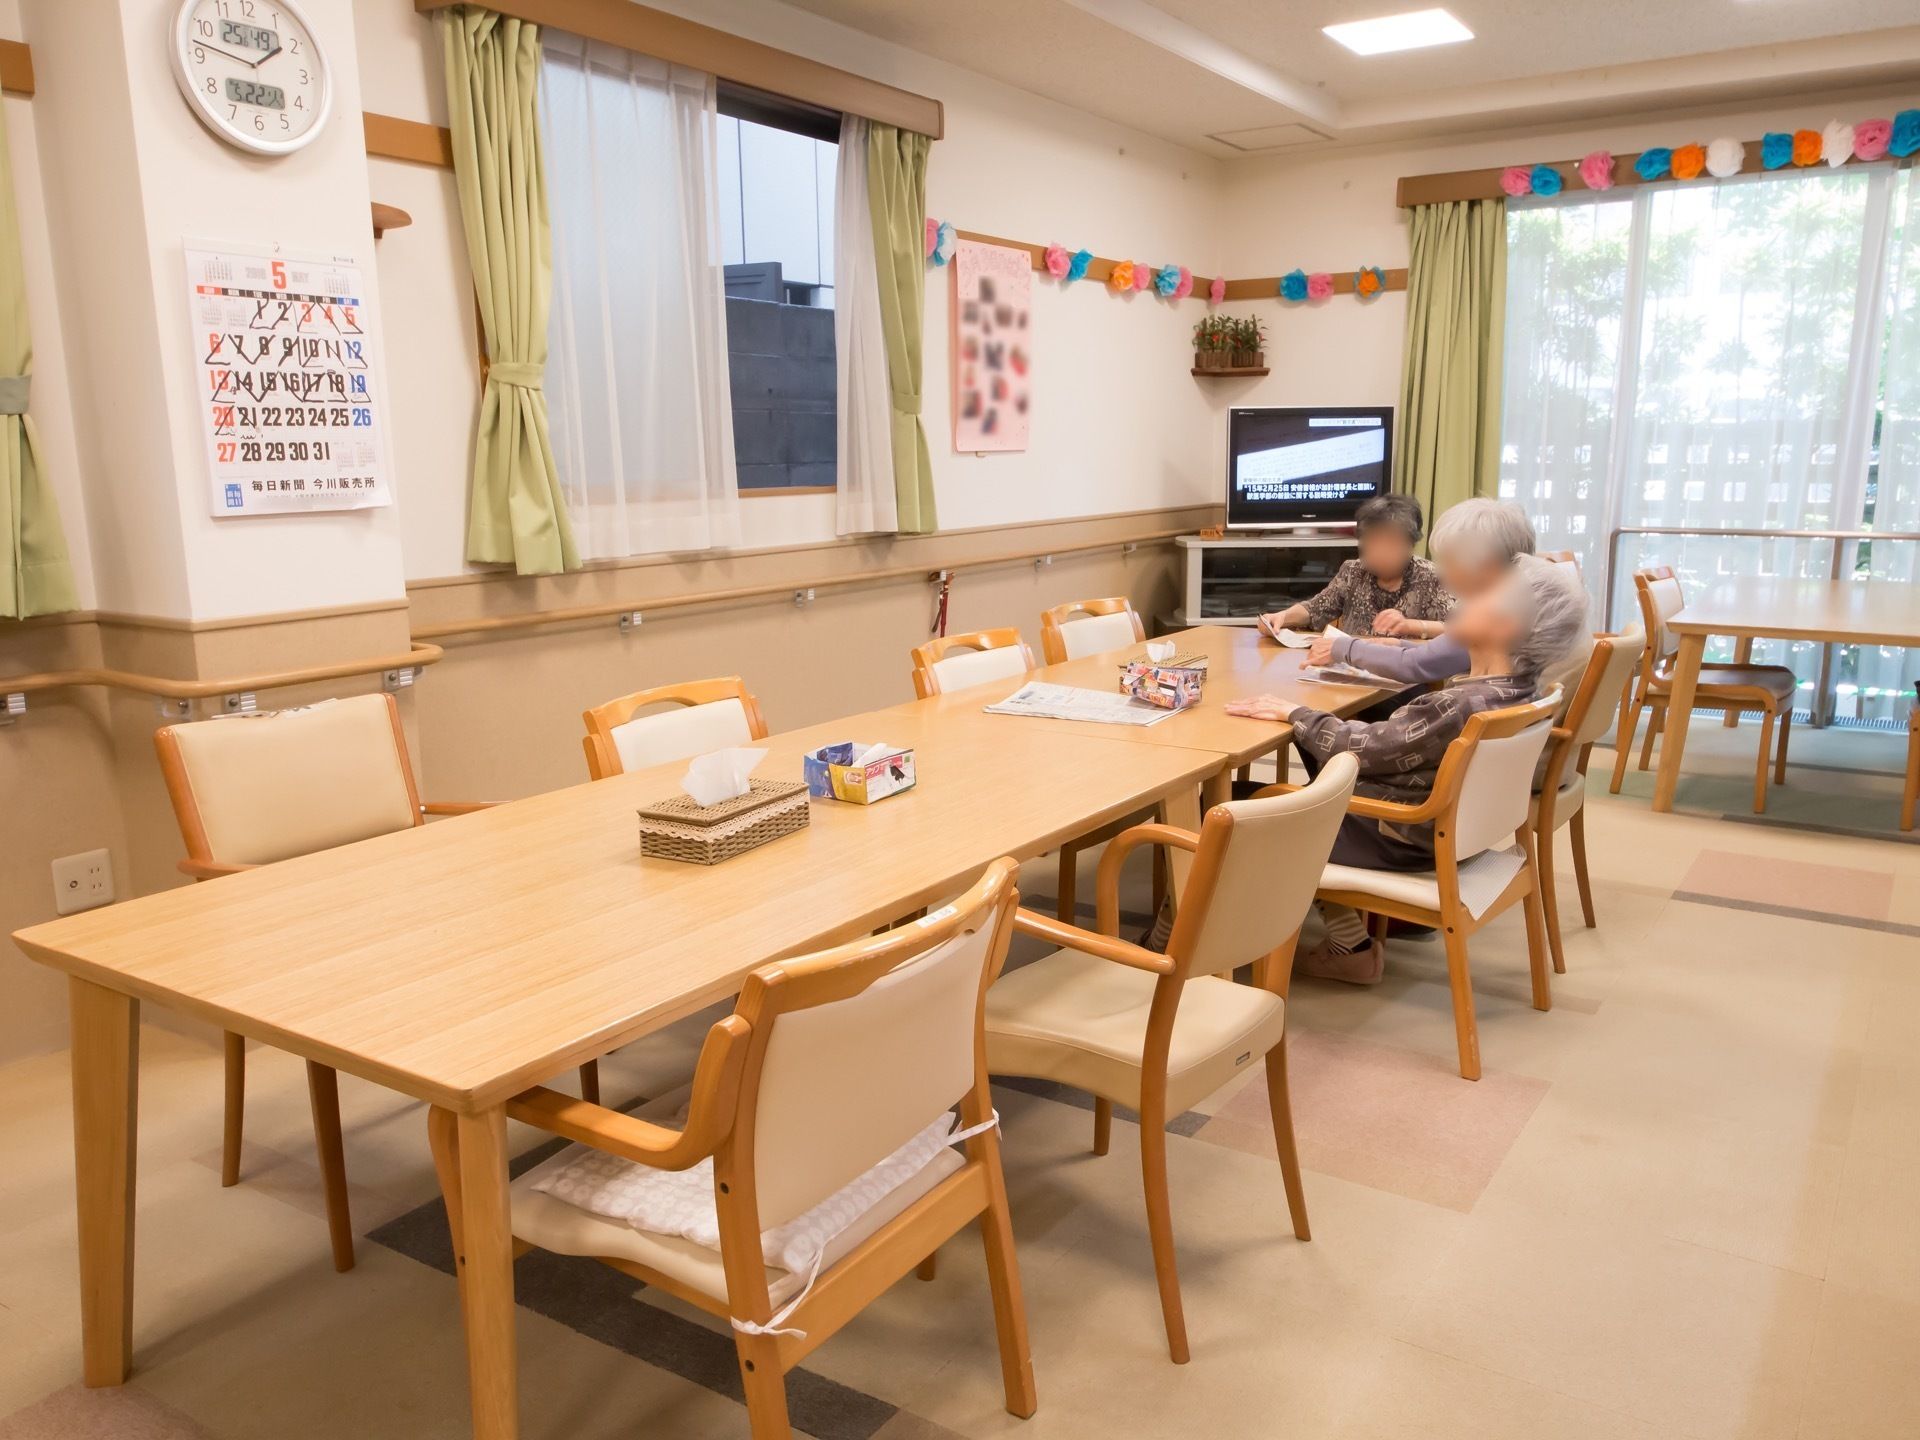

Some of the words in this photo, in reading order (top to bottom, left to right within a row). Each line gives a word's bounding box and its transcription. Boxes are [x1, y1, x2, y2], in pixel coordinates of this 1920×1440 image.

[215, 0, 229, 18] 11
[240, 0, 255, 18] 12
[197, 19, 214, 38] 10
[289, 38, 299, 55] 2
[194, 48, 206, 64] 9
[206, 77, 218, 94] 8
[299, 69, 309, 85] 3
[294, 95, 303, 111] 4
[228, 104, 237, 120] 7
[254, 115, 265, 131] 6
[280, 113, 289, 130] 5
[271, 260, 287, 290] 5
[278, 302, 289, 321] 2
[301, 303, 311, 322] 3
[324, 305, 333, 324] 4
[345, 306, 355, 326] 5
[209, 333, 221, 354] 6
[234, 335, 243, 354] 7
[259, 336, 269, 355] 8
[283, 337, 293, 357] 9
[302, 338, 319, 357] 10
[325, 339, 341, 358] 11
[346, 340, 362, 359] 12
[210, 370, 229, 390] 13
[235, 371, 253, 391] 14
[260, 371, 277, 391] 15
[283, 372, 300, 392] 16
[306, 373, 323, 392] 17
[329, 374, 345, 393] 18
[350, 374, 366, 393] 19
[213, 406, 235, 427] 20
[239, 406, 257, 426] 21
[261, 407, 282, 426] 22
[285, 407, 305, 426] 23
[308, 407, 327, 426] 24
[330, 408, 349, 426] 25
[352, 408, 372, 426] 26
[216, 442, 237, 463] 27
[240, 442, 262, 463] 28
[265, 442, 286, 462] 29
[289, 442, 309, 461] 30
[313, 441, 330, 461] 31
[251, 479, 305, 493] 毎日新聞
[313, 477, 375, 490] 今川販売所
